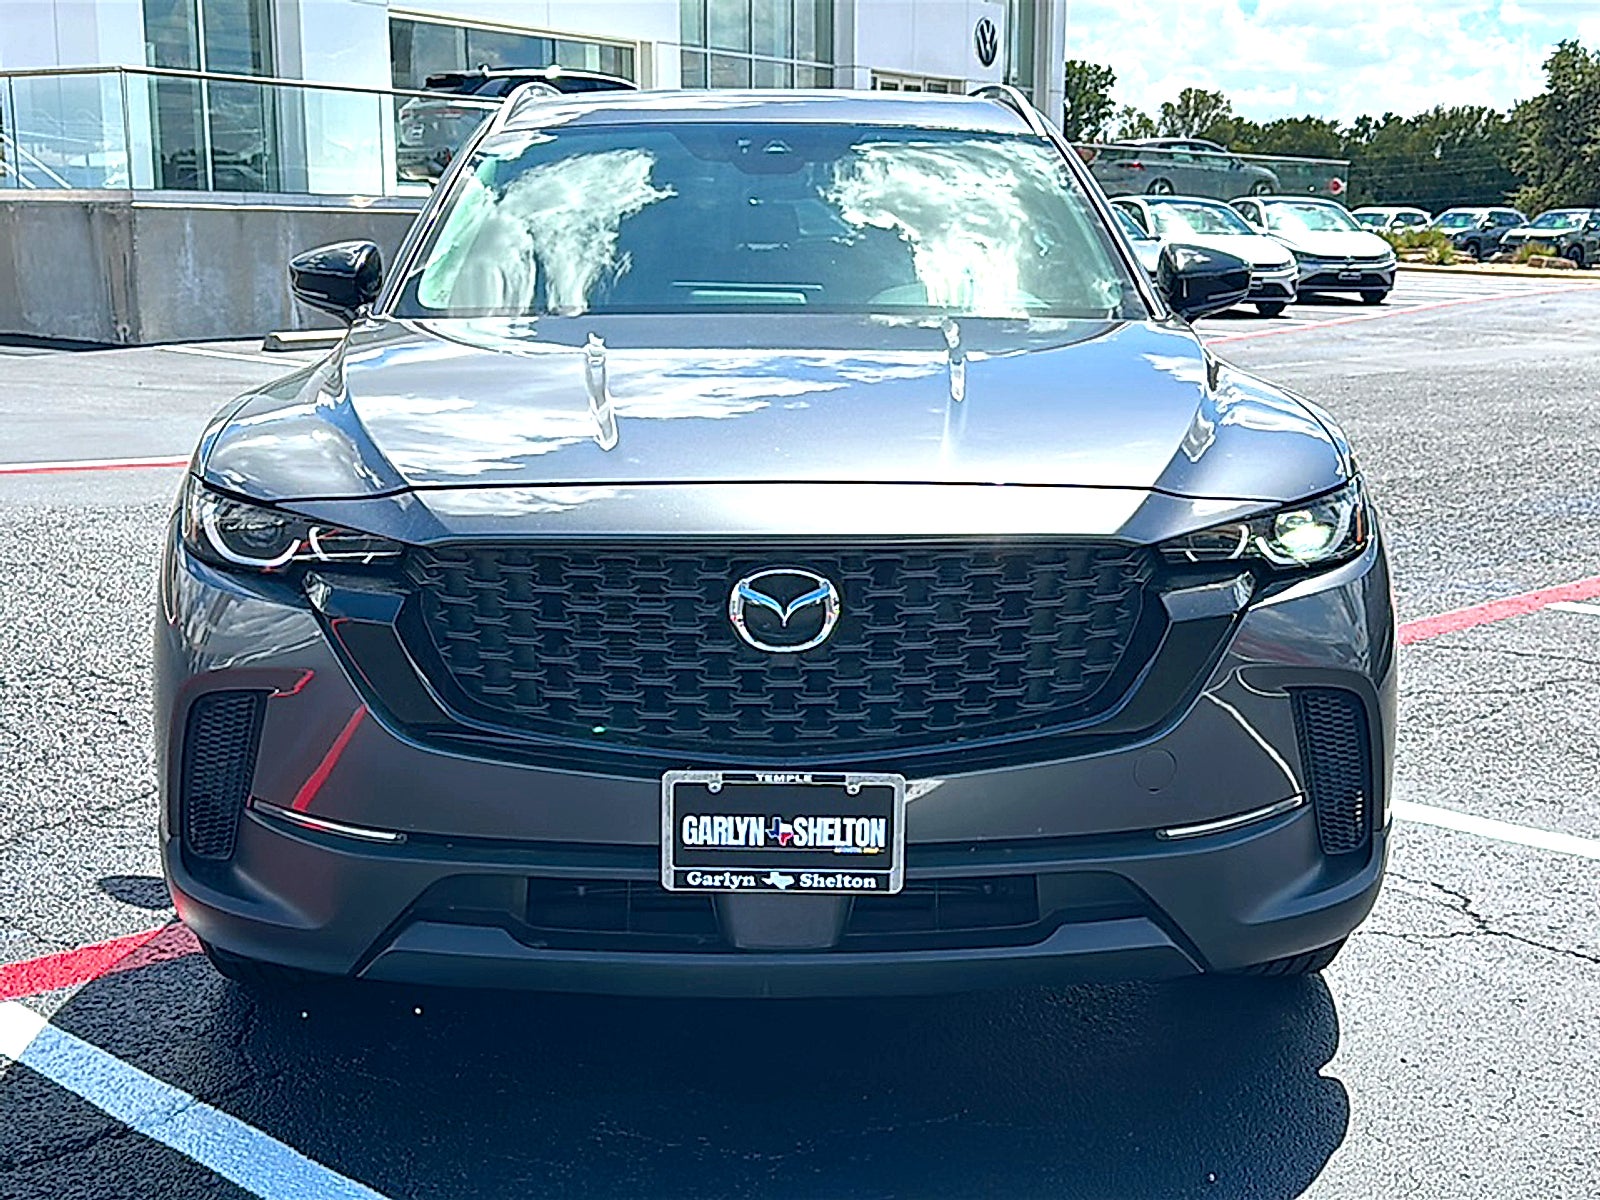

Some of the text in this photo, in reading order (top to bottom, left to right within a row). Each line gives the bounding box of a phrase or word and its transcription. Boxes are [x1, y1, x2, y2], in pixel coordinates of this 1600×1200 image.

[755, 773, 812, 782] TEMPLE
[682, 815, 886, 847] GARLYN SHELTON
[687, 872, 877, 889] Garlyn Shelton
